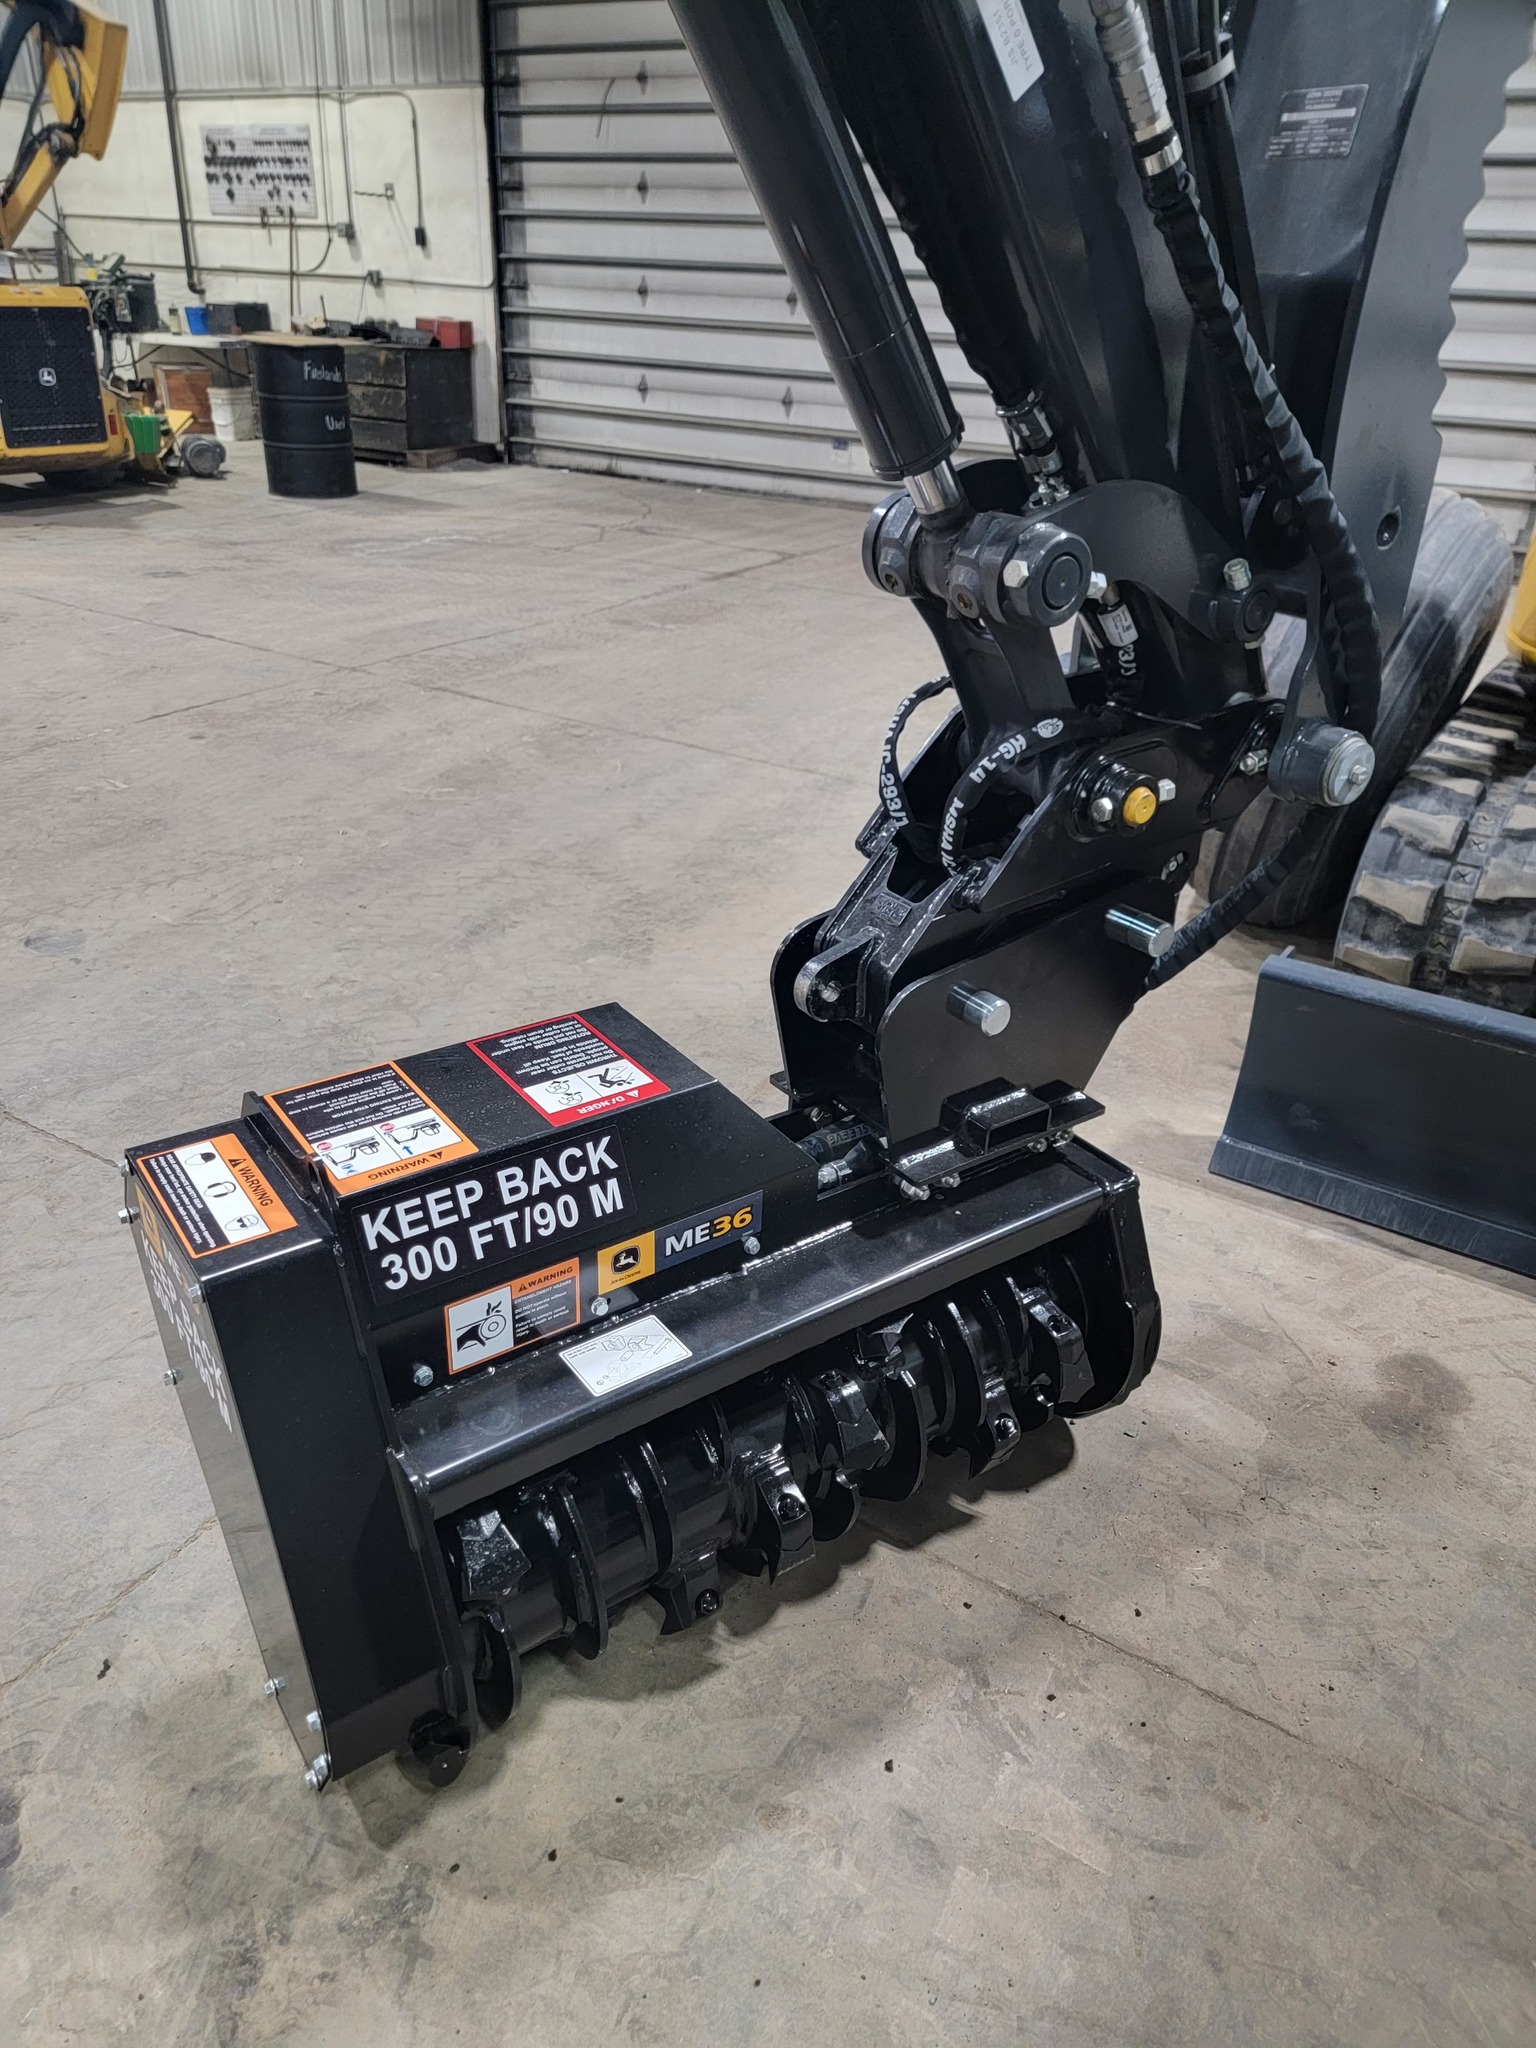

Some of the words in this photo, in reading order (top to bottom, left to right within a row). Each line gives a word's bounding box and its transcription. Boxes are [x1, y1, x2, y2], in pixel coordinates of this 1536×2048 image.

[1017, 39, 1032, 71] TYPE
[969, 734, 1027, 784] HG-14
[941, 797, 965, 850] MSHA
[533, 1040, 556, 1049] DRUM
[555, 1030, 591, 1043] ROTATING
[546, 1062, 565, 1070] cutter
[551, 1062, 585, 1074] OBJECTS
[566, 1055, 590, 1064] operate
[585, 1053, 617, 1064] THROWN
[316, 1142, 331, 1150] STOP
[367, 1157, 429, 1179] WARNING
[238, 1166, 273, 1206] WARNING
[361, 1180, 483, 1250] KEEP
[496, 1135, 618, 1204] BACK
[381, 1236, 457, 1289] 300
[468, 1194, 578, 1259] FT/90
[588, 1177, 623, 1217] M
[666, 1207, 753, 1256] ME36
[528, 1266, 572, 1287] WARNING
[610, 1276, 624, 1285] JOHN
[625, 1270, 641, 1280] DEERE
[514, 1286, 551, 1303] ENTANGLEMENT
[552, 1279, 571, 1288] HAZARD
[140, 1229, 177, 1304] KEEP
[179, 1299, 227, 1401] BACK
[150, 1269, 175, 1325] 300
[215, 1387, 232, 1433] M
